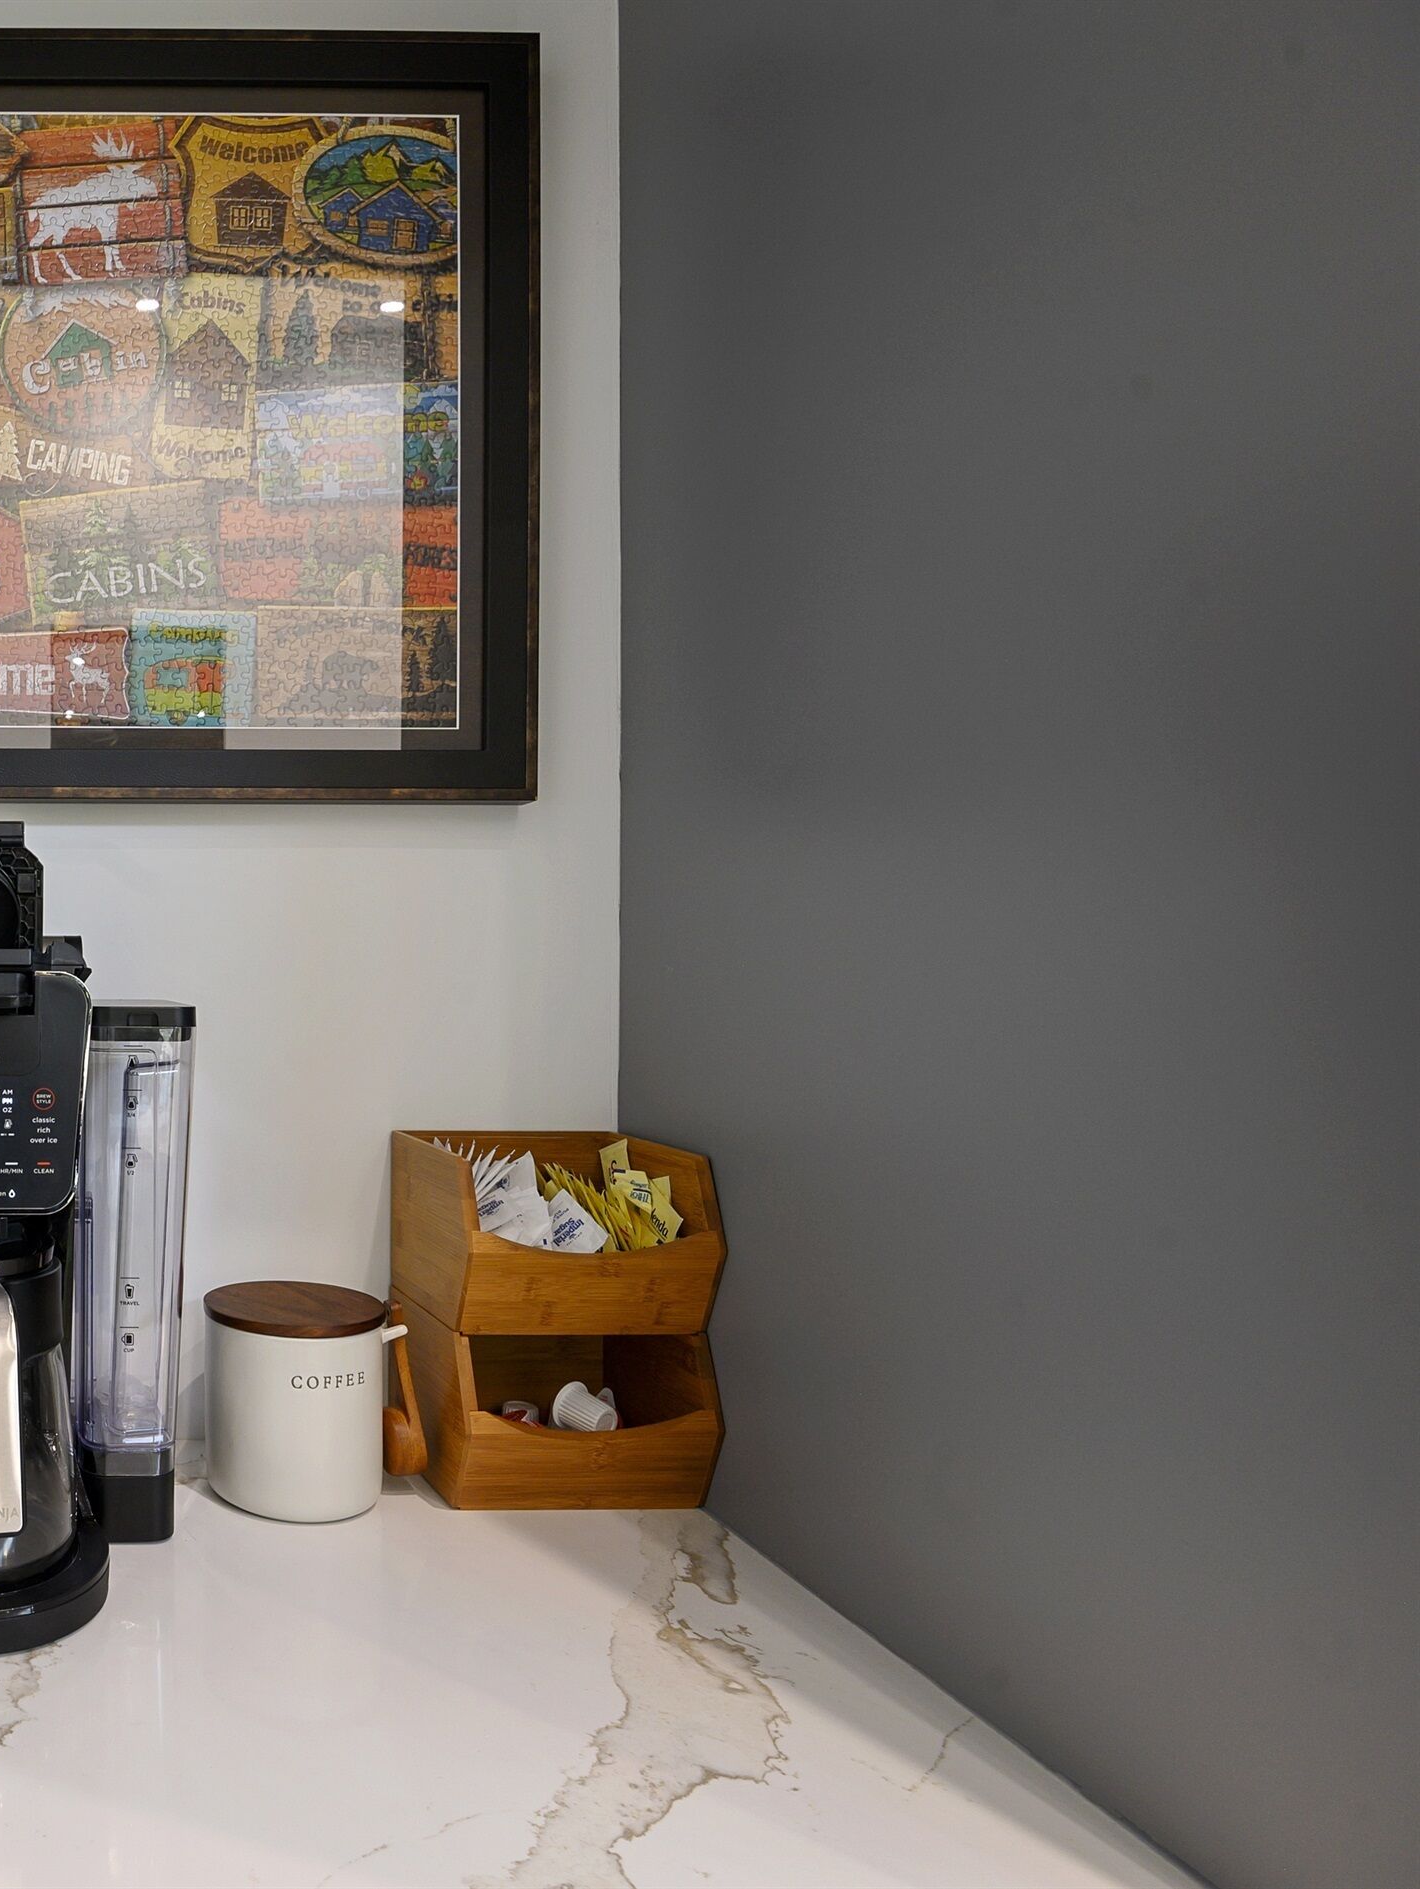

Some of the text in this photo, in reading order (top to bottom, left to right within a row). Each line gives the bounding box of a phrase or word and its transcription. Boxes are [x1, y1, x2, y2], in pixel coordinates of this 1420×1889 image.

[176, 290, 247, 316] Cabins
[21, 348, 148, 395] Cabin
[286, 411, 449, 440] Welcome
[25, 437, 132, 487] CAMPING
[43, 556, 208, 604] CABINS
[1, 1088, 14, 1096] AM
[31, 1116, 56, 1124] classic
[36, 1126, 51, 1134] rich
[552, 1217, 575, 1238] Sugar
[553, 1219, 586, 1248] Imperial
[649, 1208, 670, 1238] lenda
[290, 1371, 366, 1391] COFFEE
